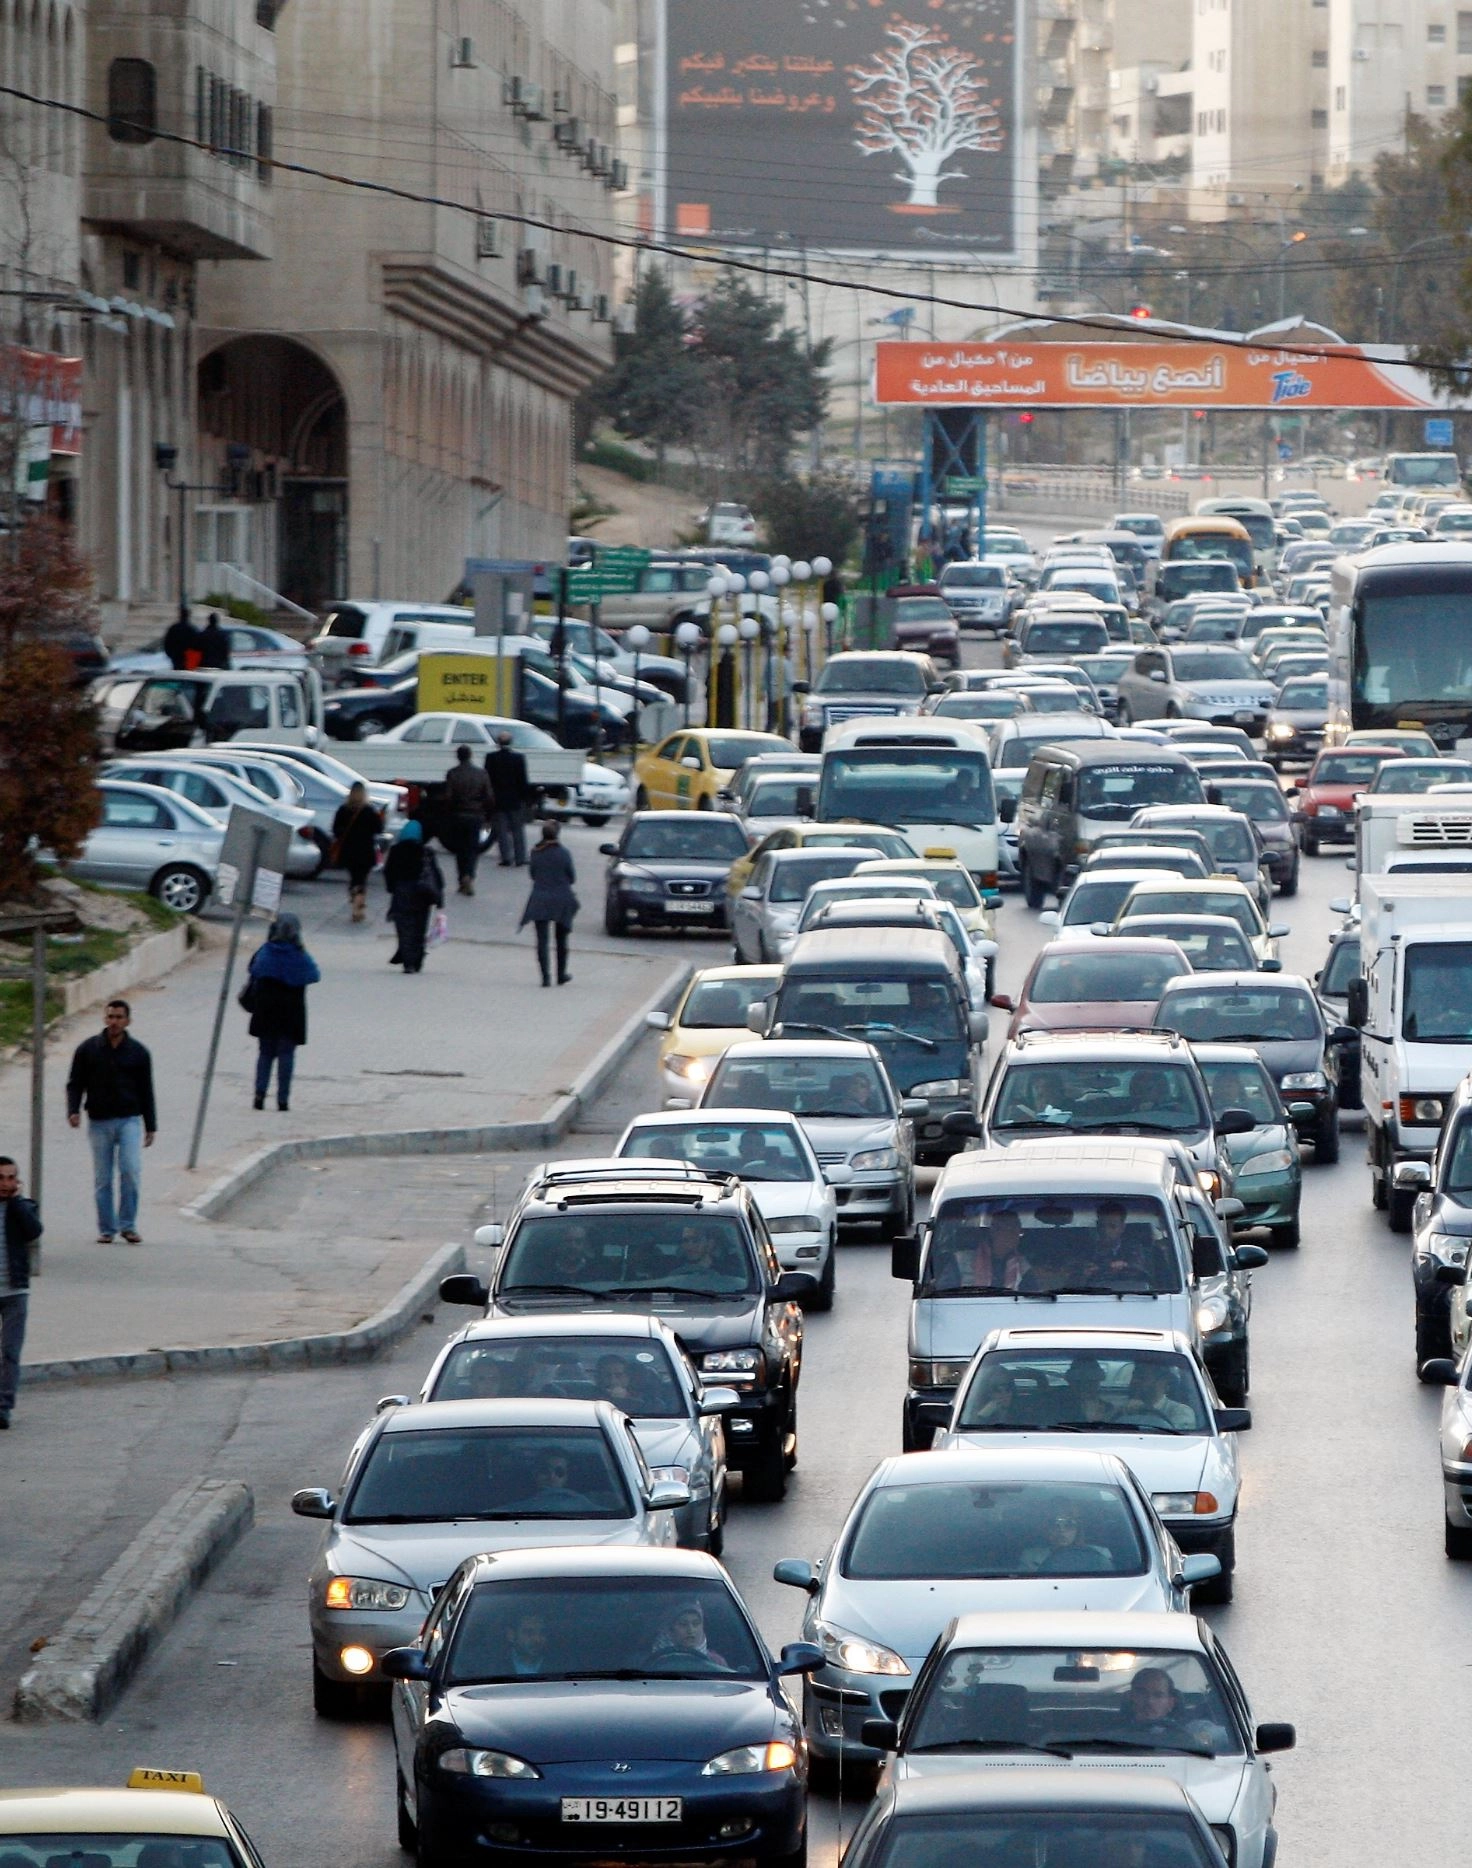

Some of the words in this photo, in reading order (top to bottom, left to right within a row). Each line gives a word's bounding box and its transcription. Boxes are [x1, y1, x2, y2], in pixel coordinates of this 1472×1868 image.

[1270, 370, 1312, 403] Tide
[443, 673, 488, 685] ENTER
[142, 1770, 187, 1783] TAXI
[586, 1801, 679, 1819] 19-49112
